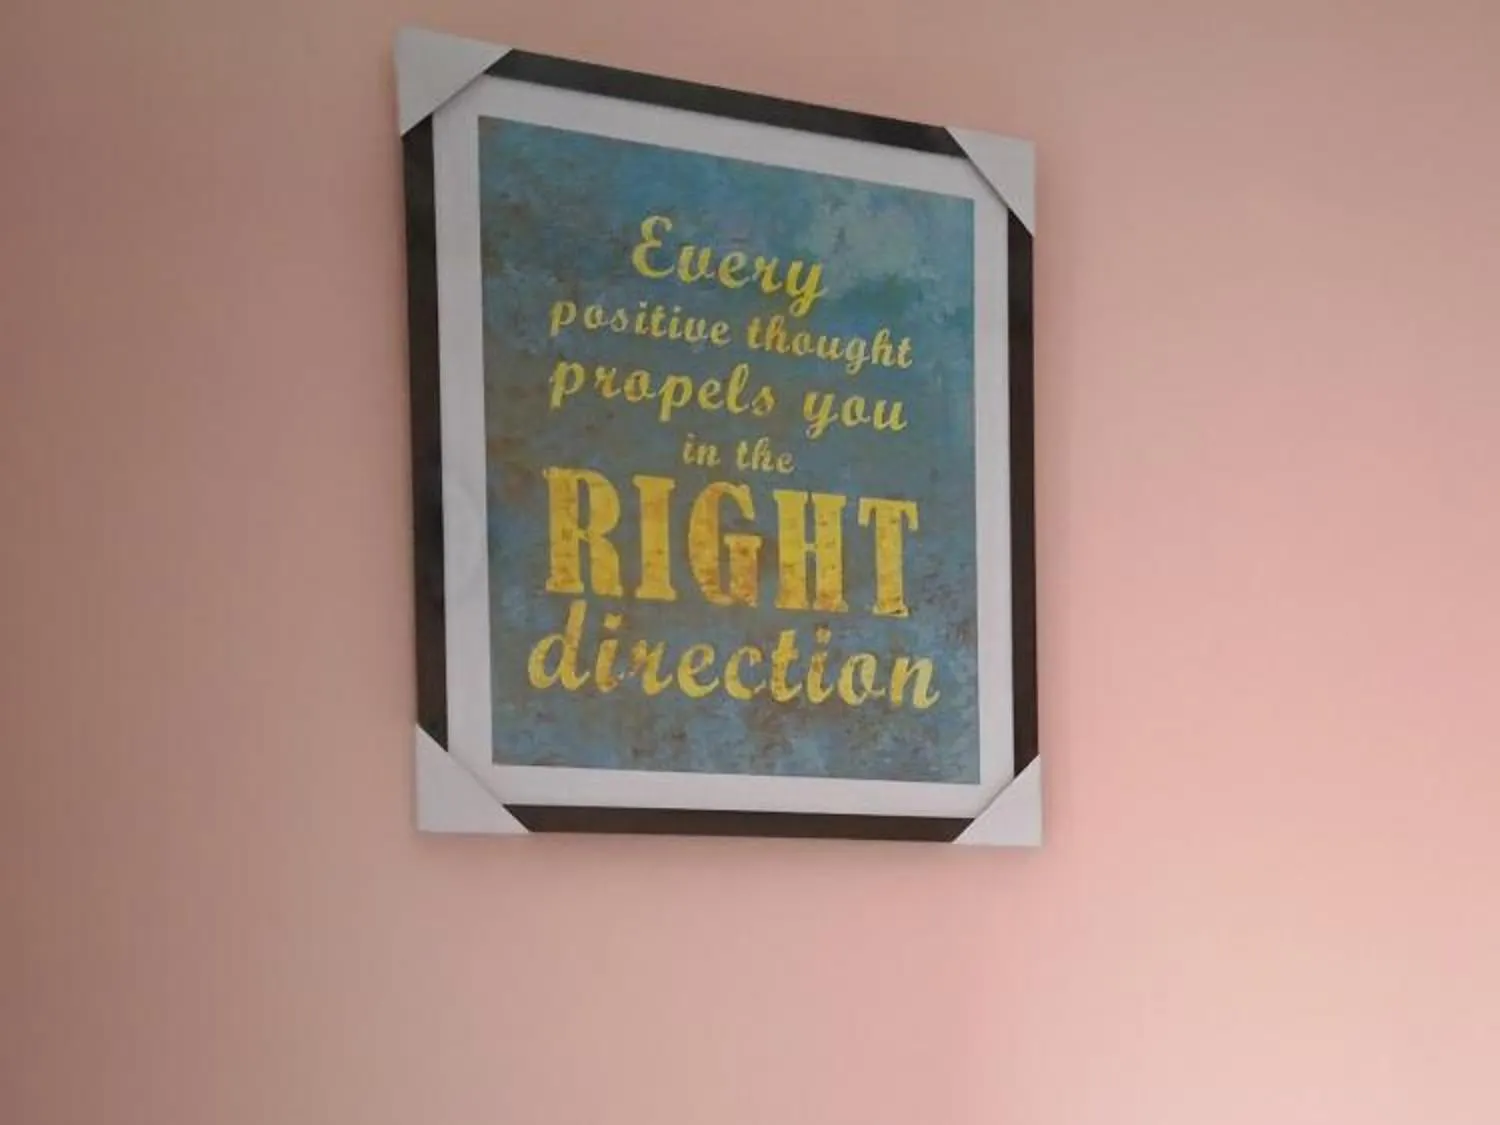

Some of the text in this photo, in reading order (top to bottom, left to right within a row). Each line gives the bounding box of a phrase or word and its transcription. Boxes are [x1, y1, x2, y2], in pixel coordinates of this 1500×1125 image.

[631, 214, 828, 317] Every
[549, 300, 913, 375] positive thought
[549, 358, 908, 437] propels you
[682, 433, 795, 474] in the
[543, 465, 919, 618] RIGHT
[527, 600, 940, 709] direction
